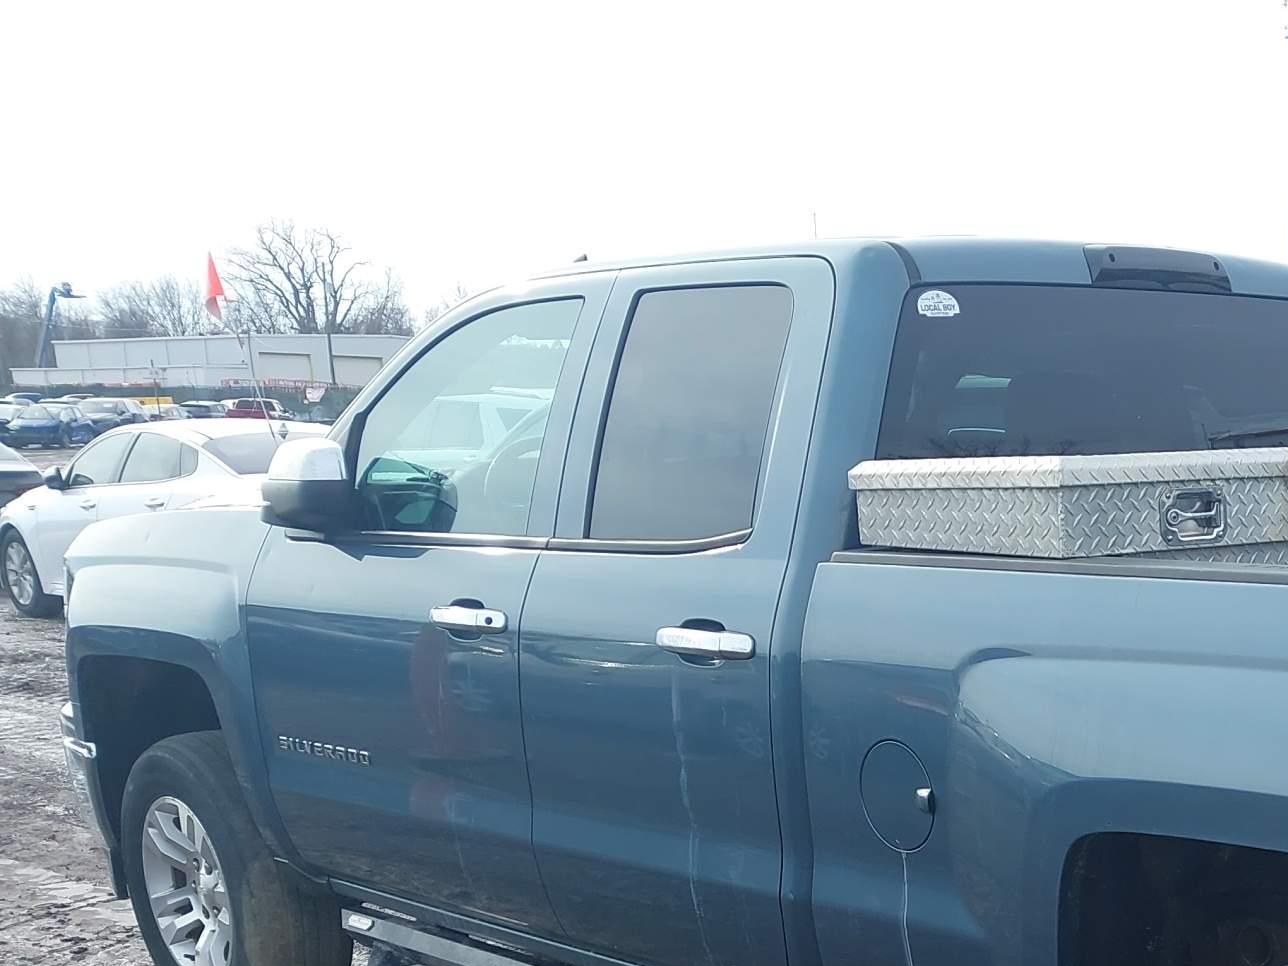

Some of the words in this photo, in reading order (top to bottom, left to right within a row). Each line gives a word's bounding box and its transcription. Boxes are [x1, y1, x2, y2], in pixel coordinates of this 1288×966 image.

[920, 303, 943, 312] LOCAL
[943, 303, 956, 312] BOY
[278, 735, 370, 768] SILVERADO
